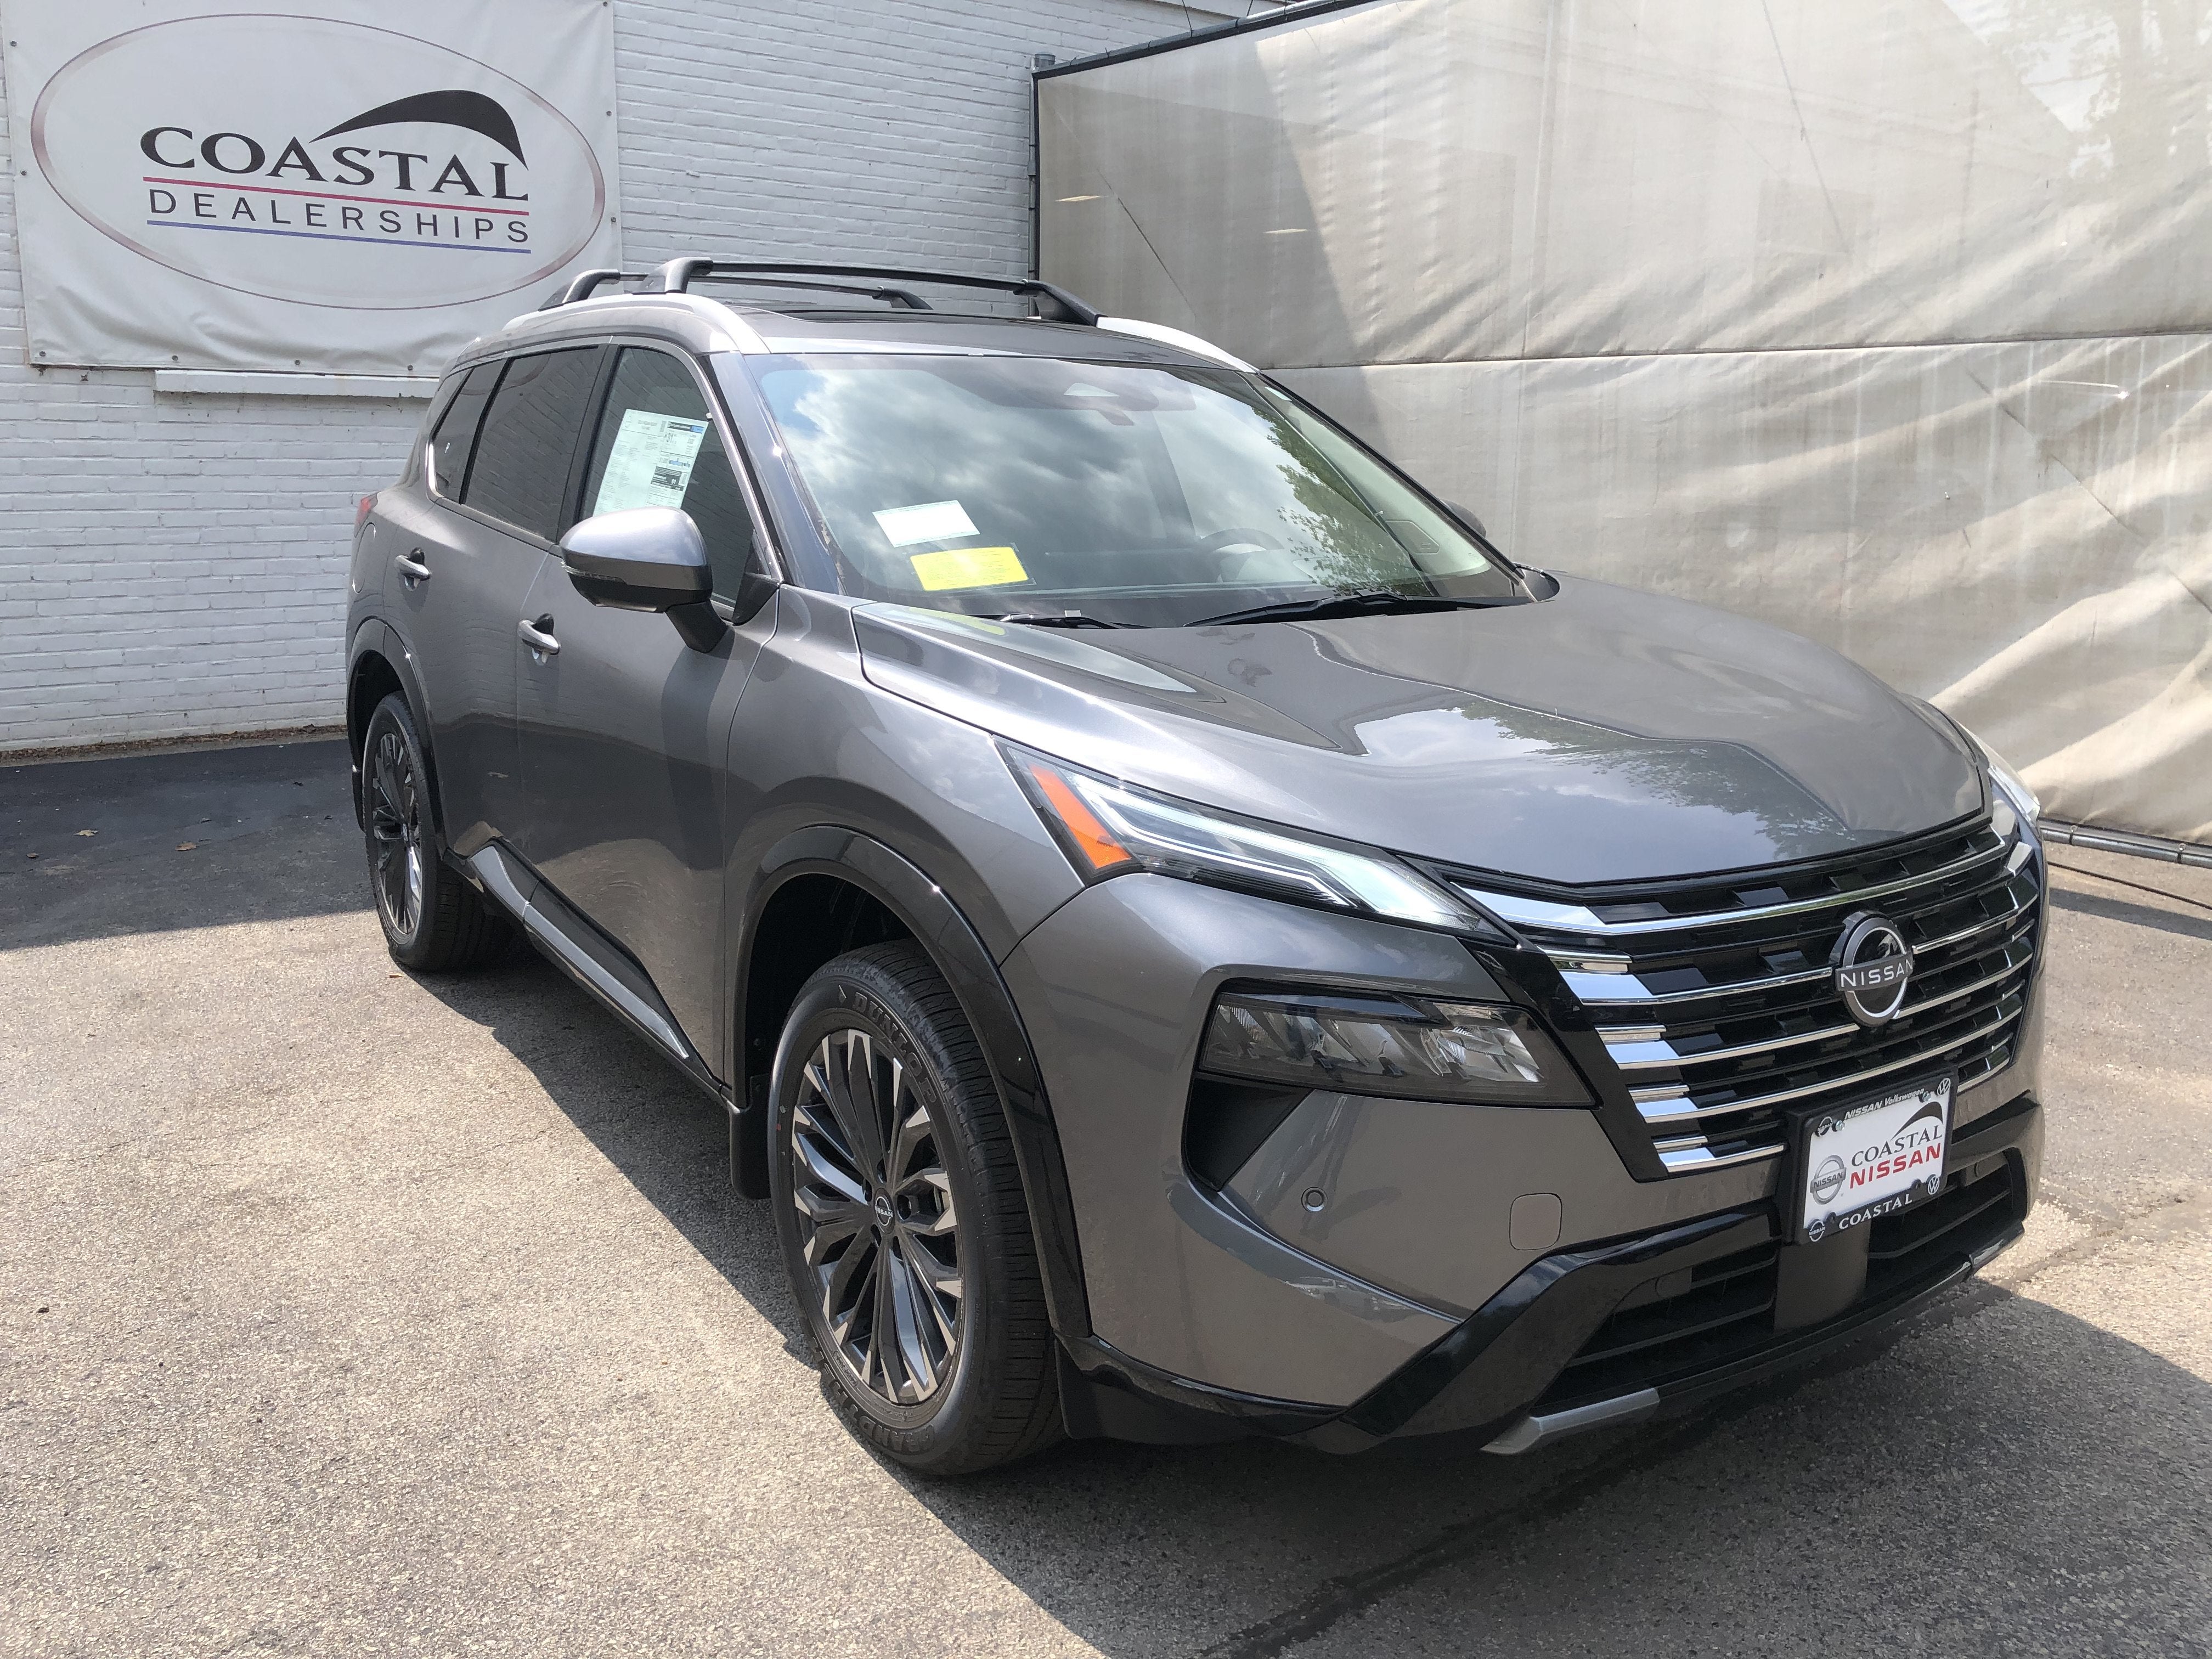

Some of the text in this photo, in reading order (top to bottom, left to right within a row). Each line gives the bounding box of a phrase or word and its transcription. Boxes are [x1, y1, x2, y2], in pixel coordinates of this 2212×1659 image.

[140, 126, 529, 201] COASTAL
[149, 188, 529, 243] DEALERSHIPS
[1840, 958, 1913, 988] NISSAN
[851, 991, 936, 1103] DUNLOP
[1844, 1100, 1883, 1120] NISSAN
[1849, 1142, 1941, 1189] NISSAN
[1852, 1125, 1943, 1167] COASTAL
[1814, 1171, 1843, 1188] NISSAN
[1839, 1193, 1912, 1230] COASTAL
